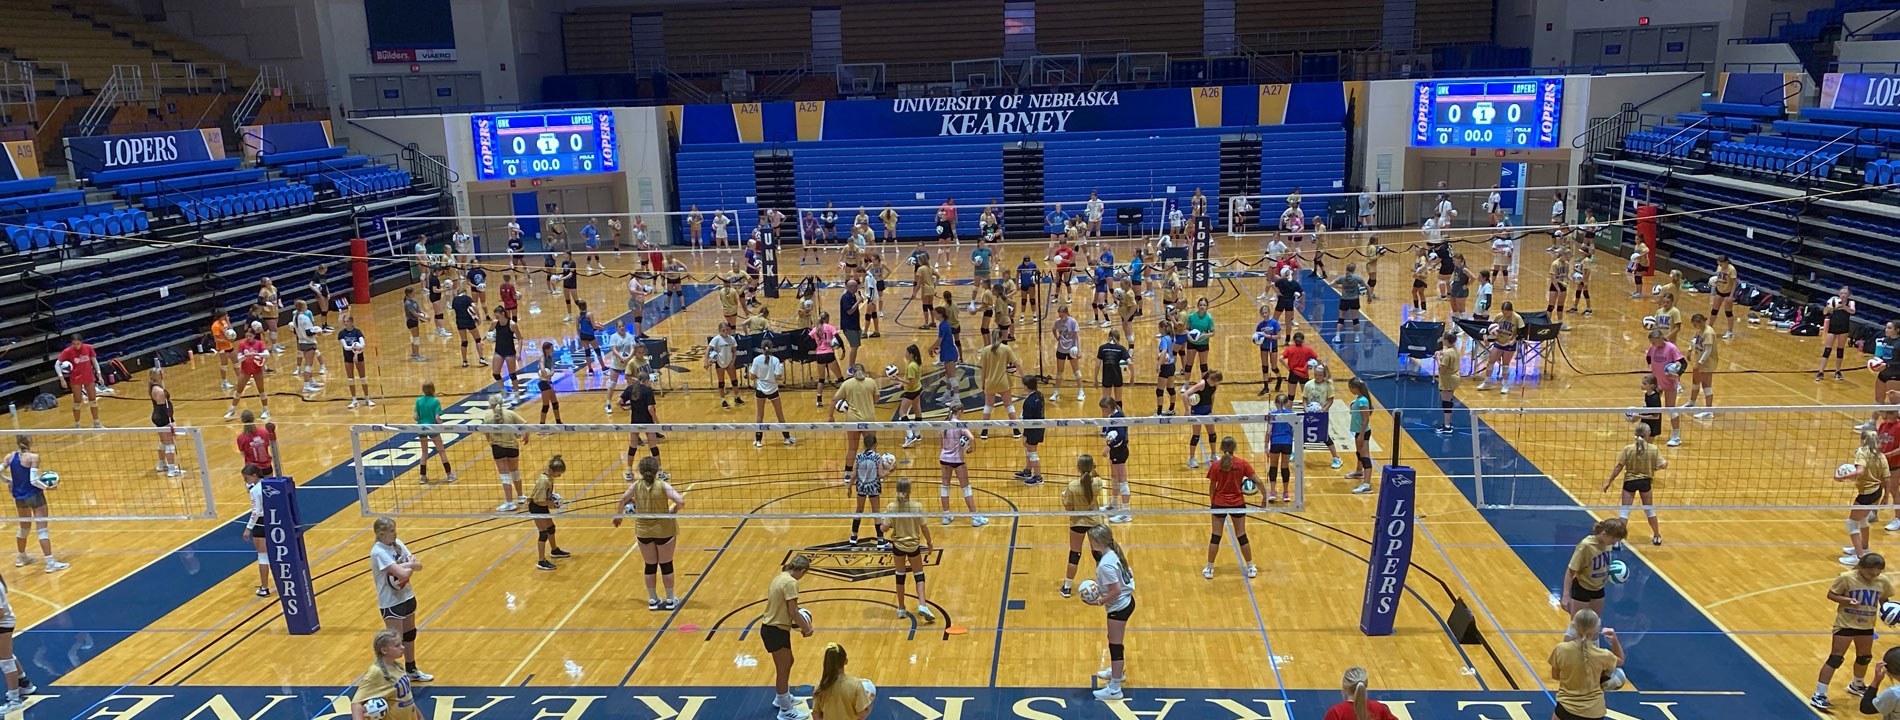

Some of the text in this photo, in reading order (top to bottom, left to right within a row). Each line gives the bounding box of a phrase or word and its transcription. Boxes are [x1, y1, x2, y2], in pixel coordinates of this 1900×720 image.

[1200, 88, 1220, 98] A26
[1262, 84, 1282, 96] A27
[1513, 84, 1536, 93] LOPERS
[740, 104, 758, 114] A24
[798, 102, 818, 112] A25
[893, 91, 1120, 113] UNIVERSITY OF NEBRASKA
[1418, 86, 1429, 142] LOPERS
[1448, 104, 1461, 122] 0
[1480, 110, 1487, 121] 1
[1508, 104, 1520, 122] 0
[1541, 82, 1556, 142] LOPERS
[571, 116, 592, 124] LOPERS
[939, 110, 1074, 136] KEARNEY
[208, 133, 221, 144] A20
[570, 134, 582, 151] 0
[600, 114, 614, 167] LOPERS
[1440, 132, 1448, 144] 0
[1464, 130, 1492, 142] 00.0
[1518, 132, 1526, 144] 0
[17, 144, 33, 158] A19
[104, 136, 178, 167] LOPERS
[478, 120, 494, 175] LOPERS
[512, 136, 526, 154] 0
[544, 140, 552, 151] 1
[508, 164, 516, 176] 0
[533, 158, 560, 171] 00.0
[584, 160, 592, 171] 0
[764, 232, 774, 277] UNK
[1196, 220, 1206, 282] LOPERS
[1306, 426, 1318, 442] 5
[270, 509, 298, 615] LOPERS
[1378, 500, 1406, 614] LOPERS
